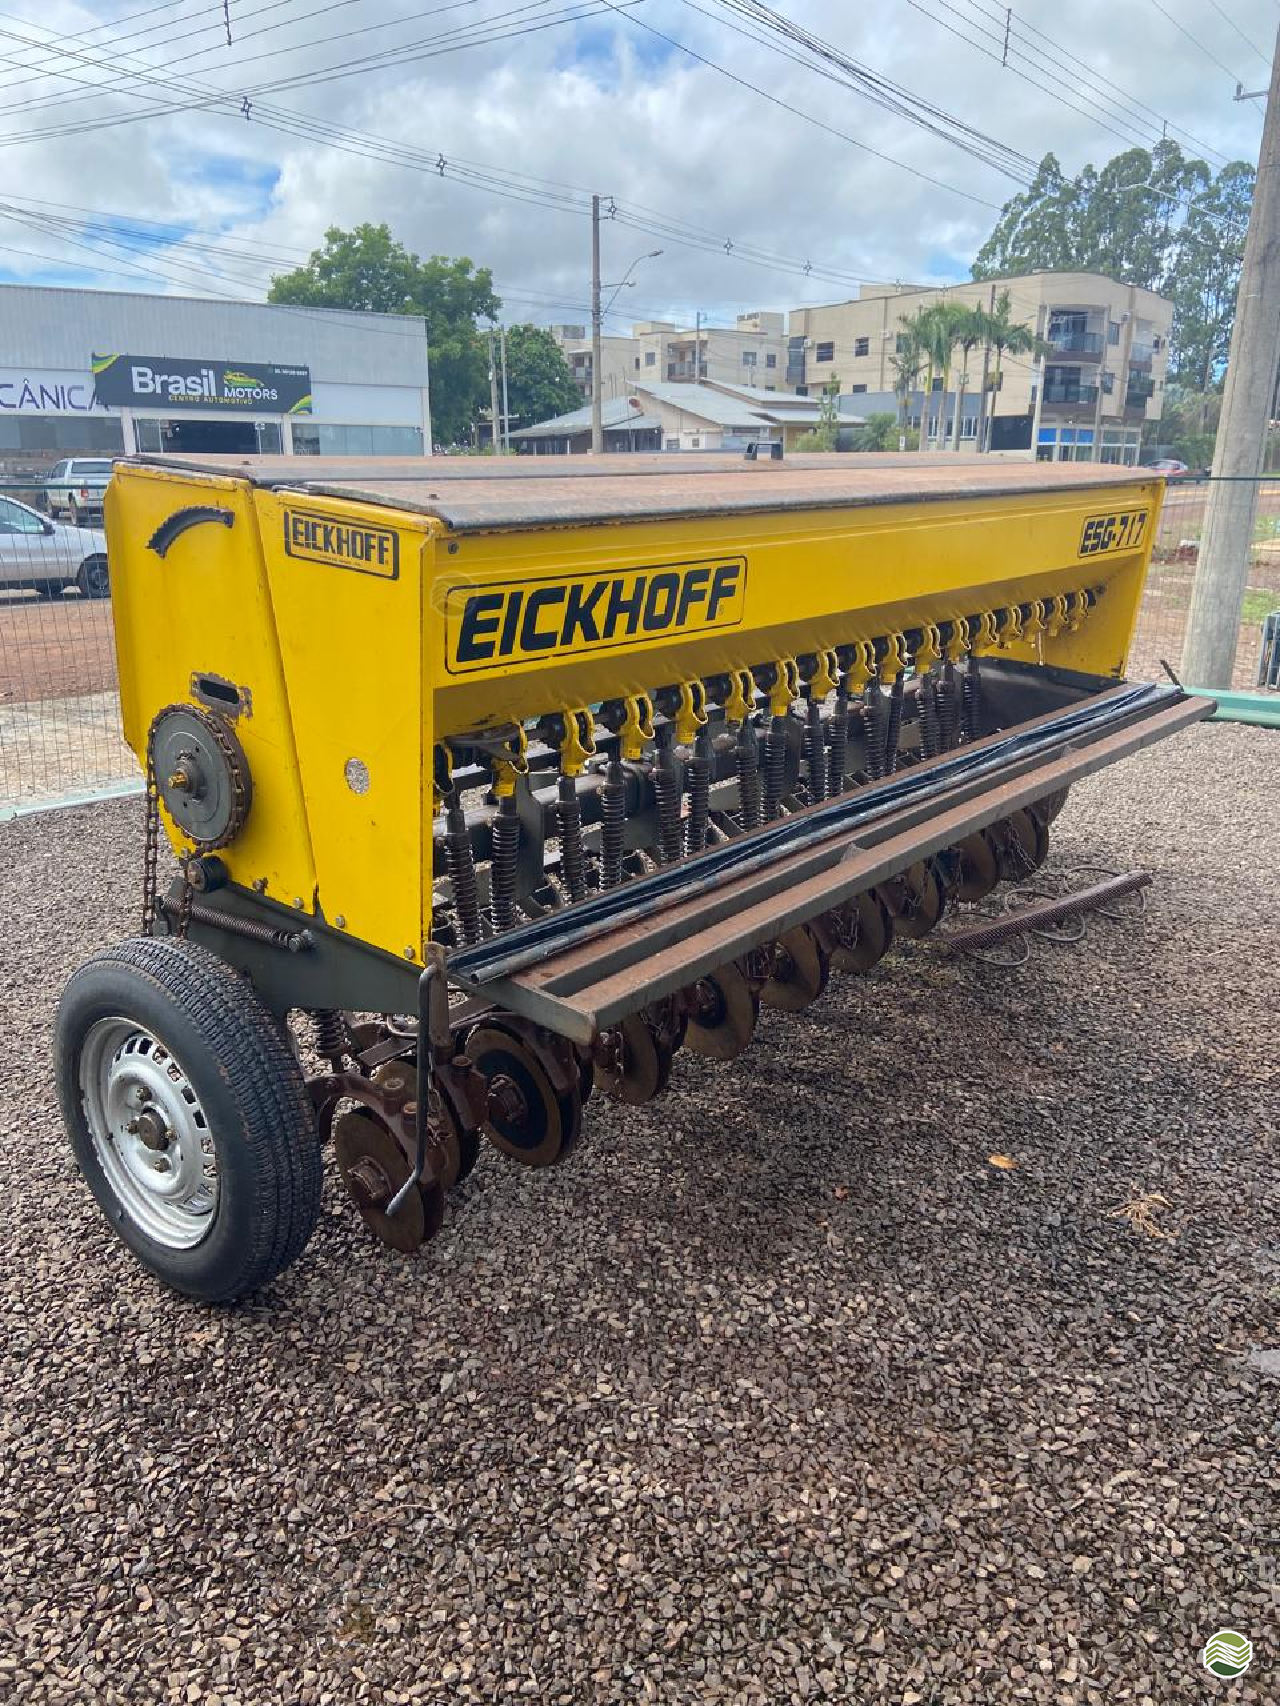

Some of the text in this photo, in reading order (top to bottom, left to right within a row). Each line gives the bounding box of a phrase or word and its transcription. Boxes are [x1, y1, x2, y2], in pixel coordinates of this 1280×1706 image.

[132, 366, 216, 397] Brasil
[168, 394, 253, 405] CENTRO AUTOMOTIVO
[224, 387, 278, 400] MOTORS
[292, 517, 390, 565] EICKHOFF
[1080, 512, 1147, 554] ESG-717
[456, 564, 741, 663] EICKHOFF
